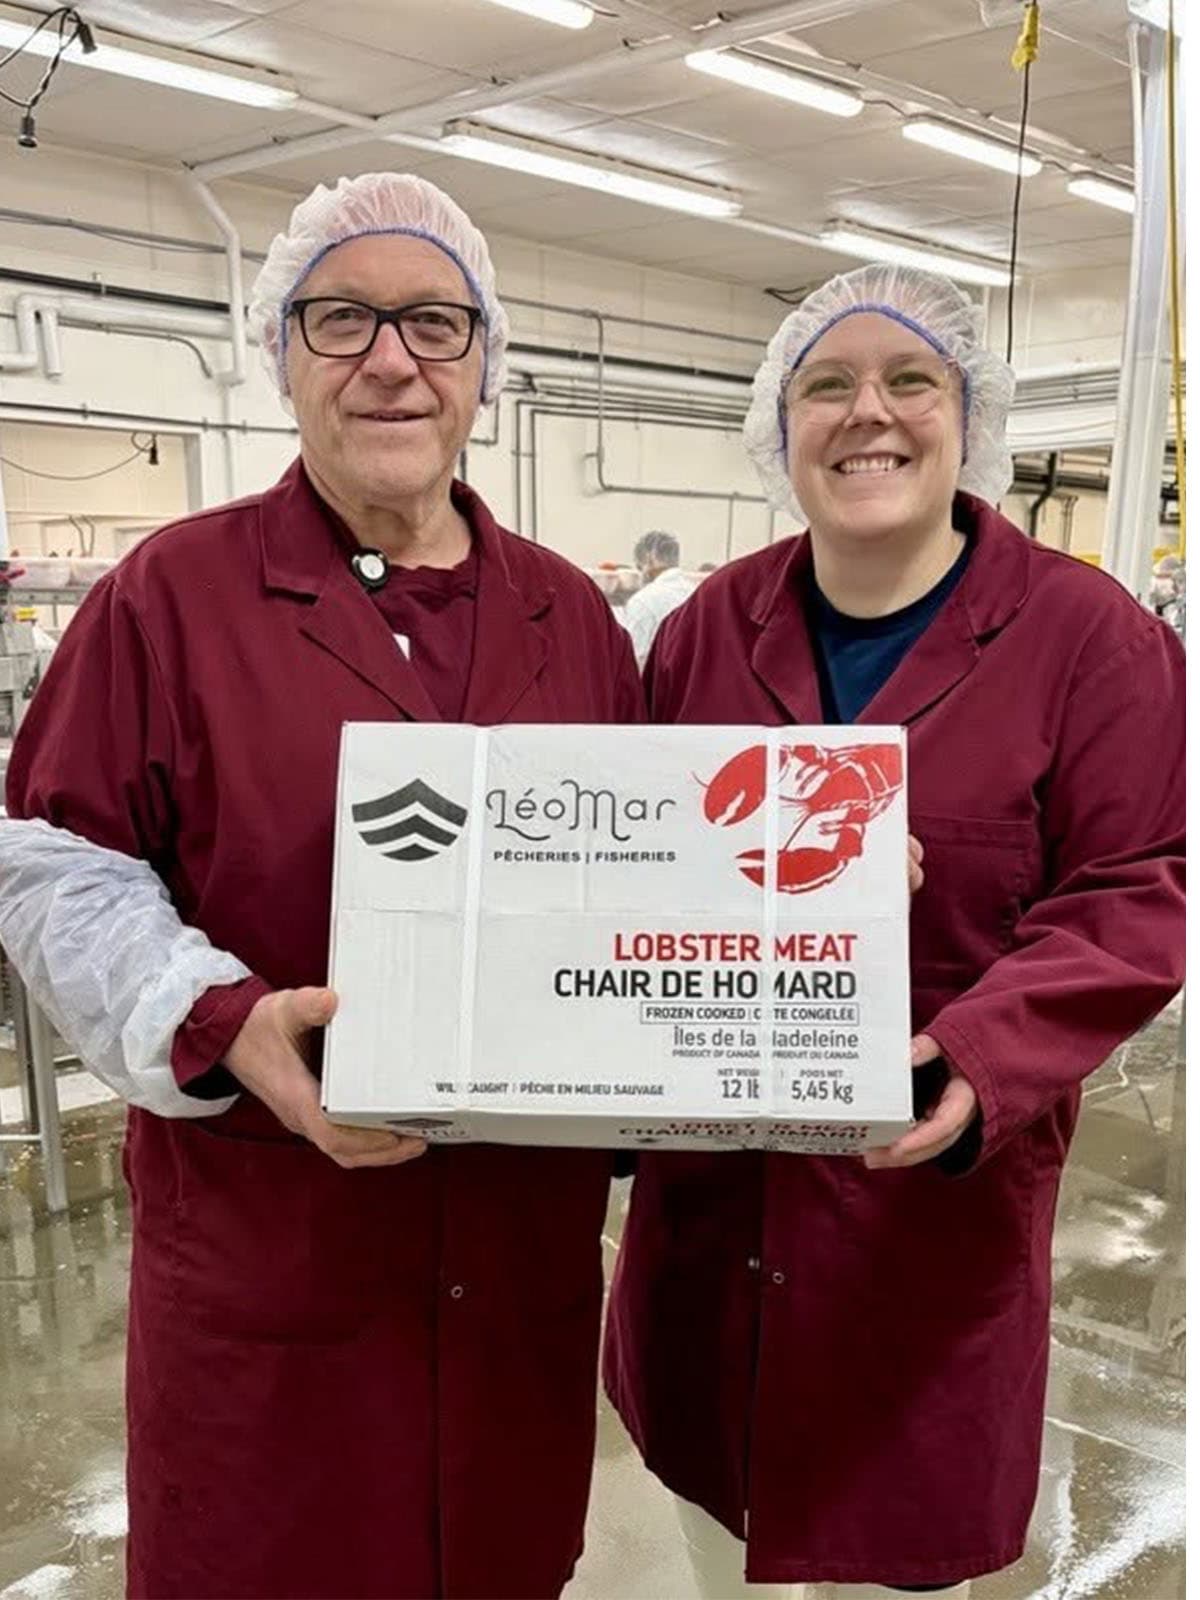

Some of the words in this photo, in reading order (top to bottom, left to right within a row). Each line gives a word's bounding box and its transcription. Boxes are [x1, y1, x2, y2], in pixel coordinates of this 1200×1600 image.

[486, 779, 677, 842] LéoMar
[494, 850, 581, 863] PÊCHERIES
[595, 851, 677, 863] FISHERIES
[614, 933, 762, 962] LOBSTER
[774, 934, 858, 962] MEAT
[554, 969, 652, 998] CHAIR
[661, 970, 703, 998] DE
[646, 1007, 694, 1020] FROZEN
[696, 1007, 746, 1020] COOKED
[754, 1008, 787, 1020] CTE
[790, 1006, 855, 1021] CONGELÉE
[711, 1029, 735, 1047] de
[740, 1029, 757, 1047] la
[772, 1029, 859, 1048] adeleine
[672, 1049, 711, 1058] PRODUCT
[713, 1050, 724, 1058] OF
[726, 1050, 760, 1059] CANADA
[824, 1051, 859, 1060] CANADA
[436, 1082, 457, 1094] WIL
[557, 1083, 573, 1095] EN
[613, 1084, 665, 1096] SAUVAGE
[722, 1079, 742, 1099] 12
[791, 1080, 829, 1102] 5,45
[832, 1080, 854, 1105] kg
